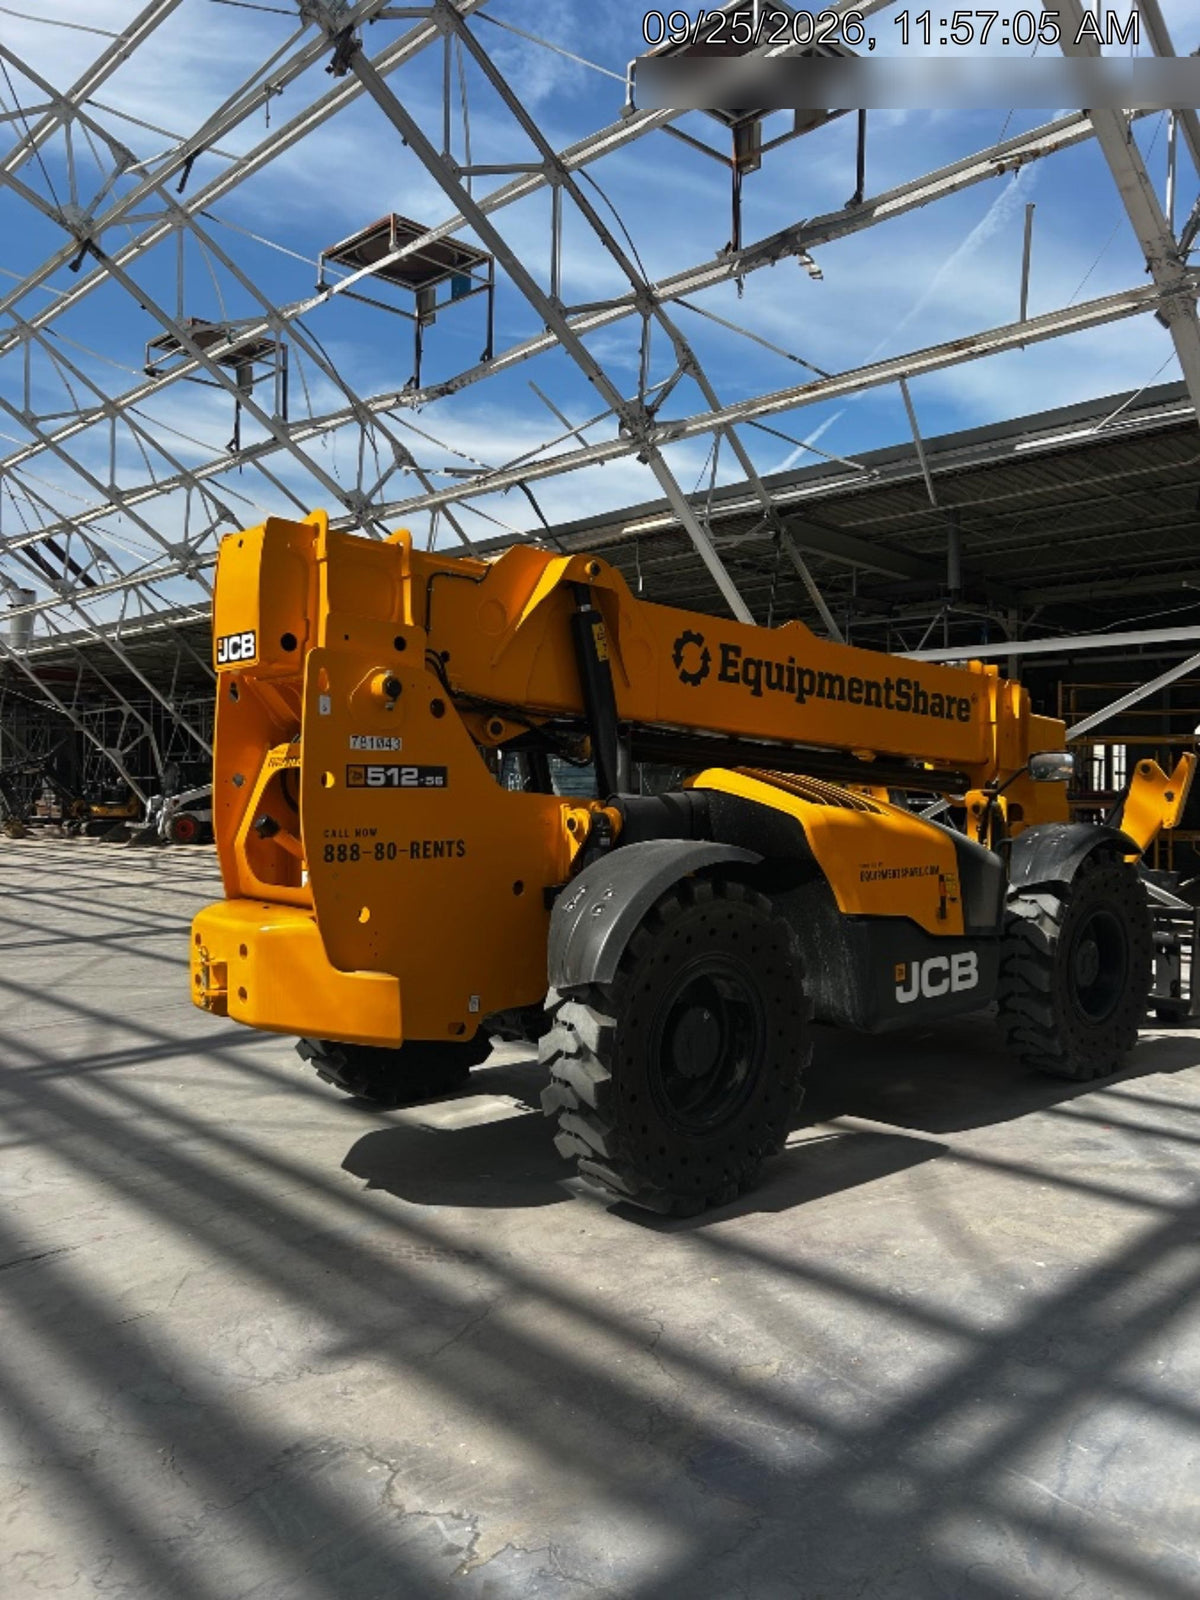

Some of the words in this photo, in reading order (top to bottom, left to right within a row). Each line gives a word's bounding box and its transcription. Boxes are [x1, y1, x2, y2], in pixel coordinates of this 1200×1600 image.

[218, 632, 255, 662] JCB
[323, 828, 350, 838] CALL
[355, 827, 378, 838] NOW
[323, 839, 467, 863] 888-80-RENTS
[895, 950, 979, 1004] JCB
